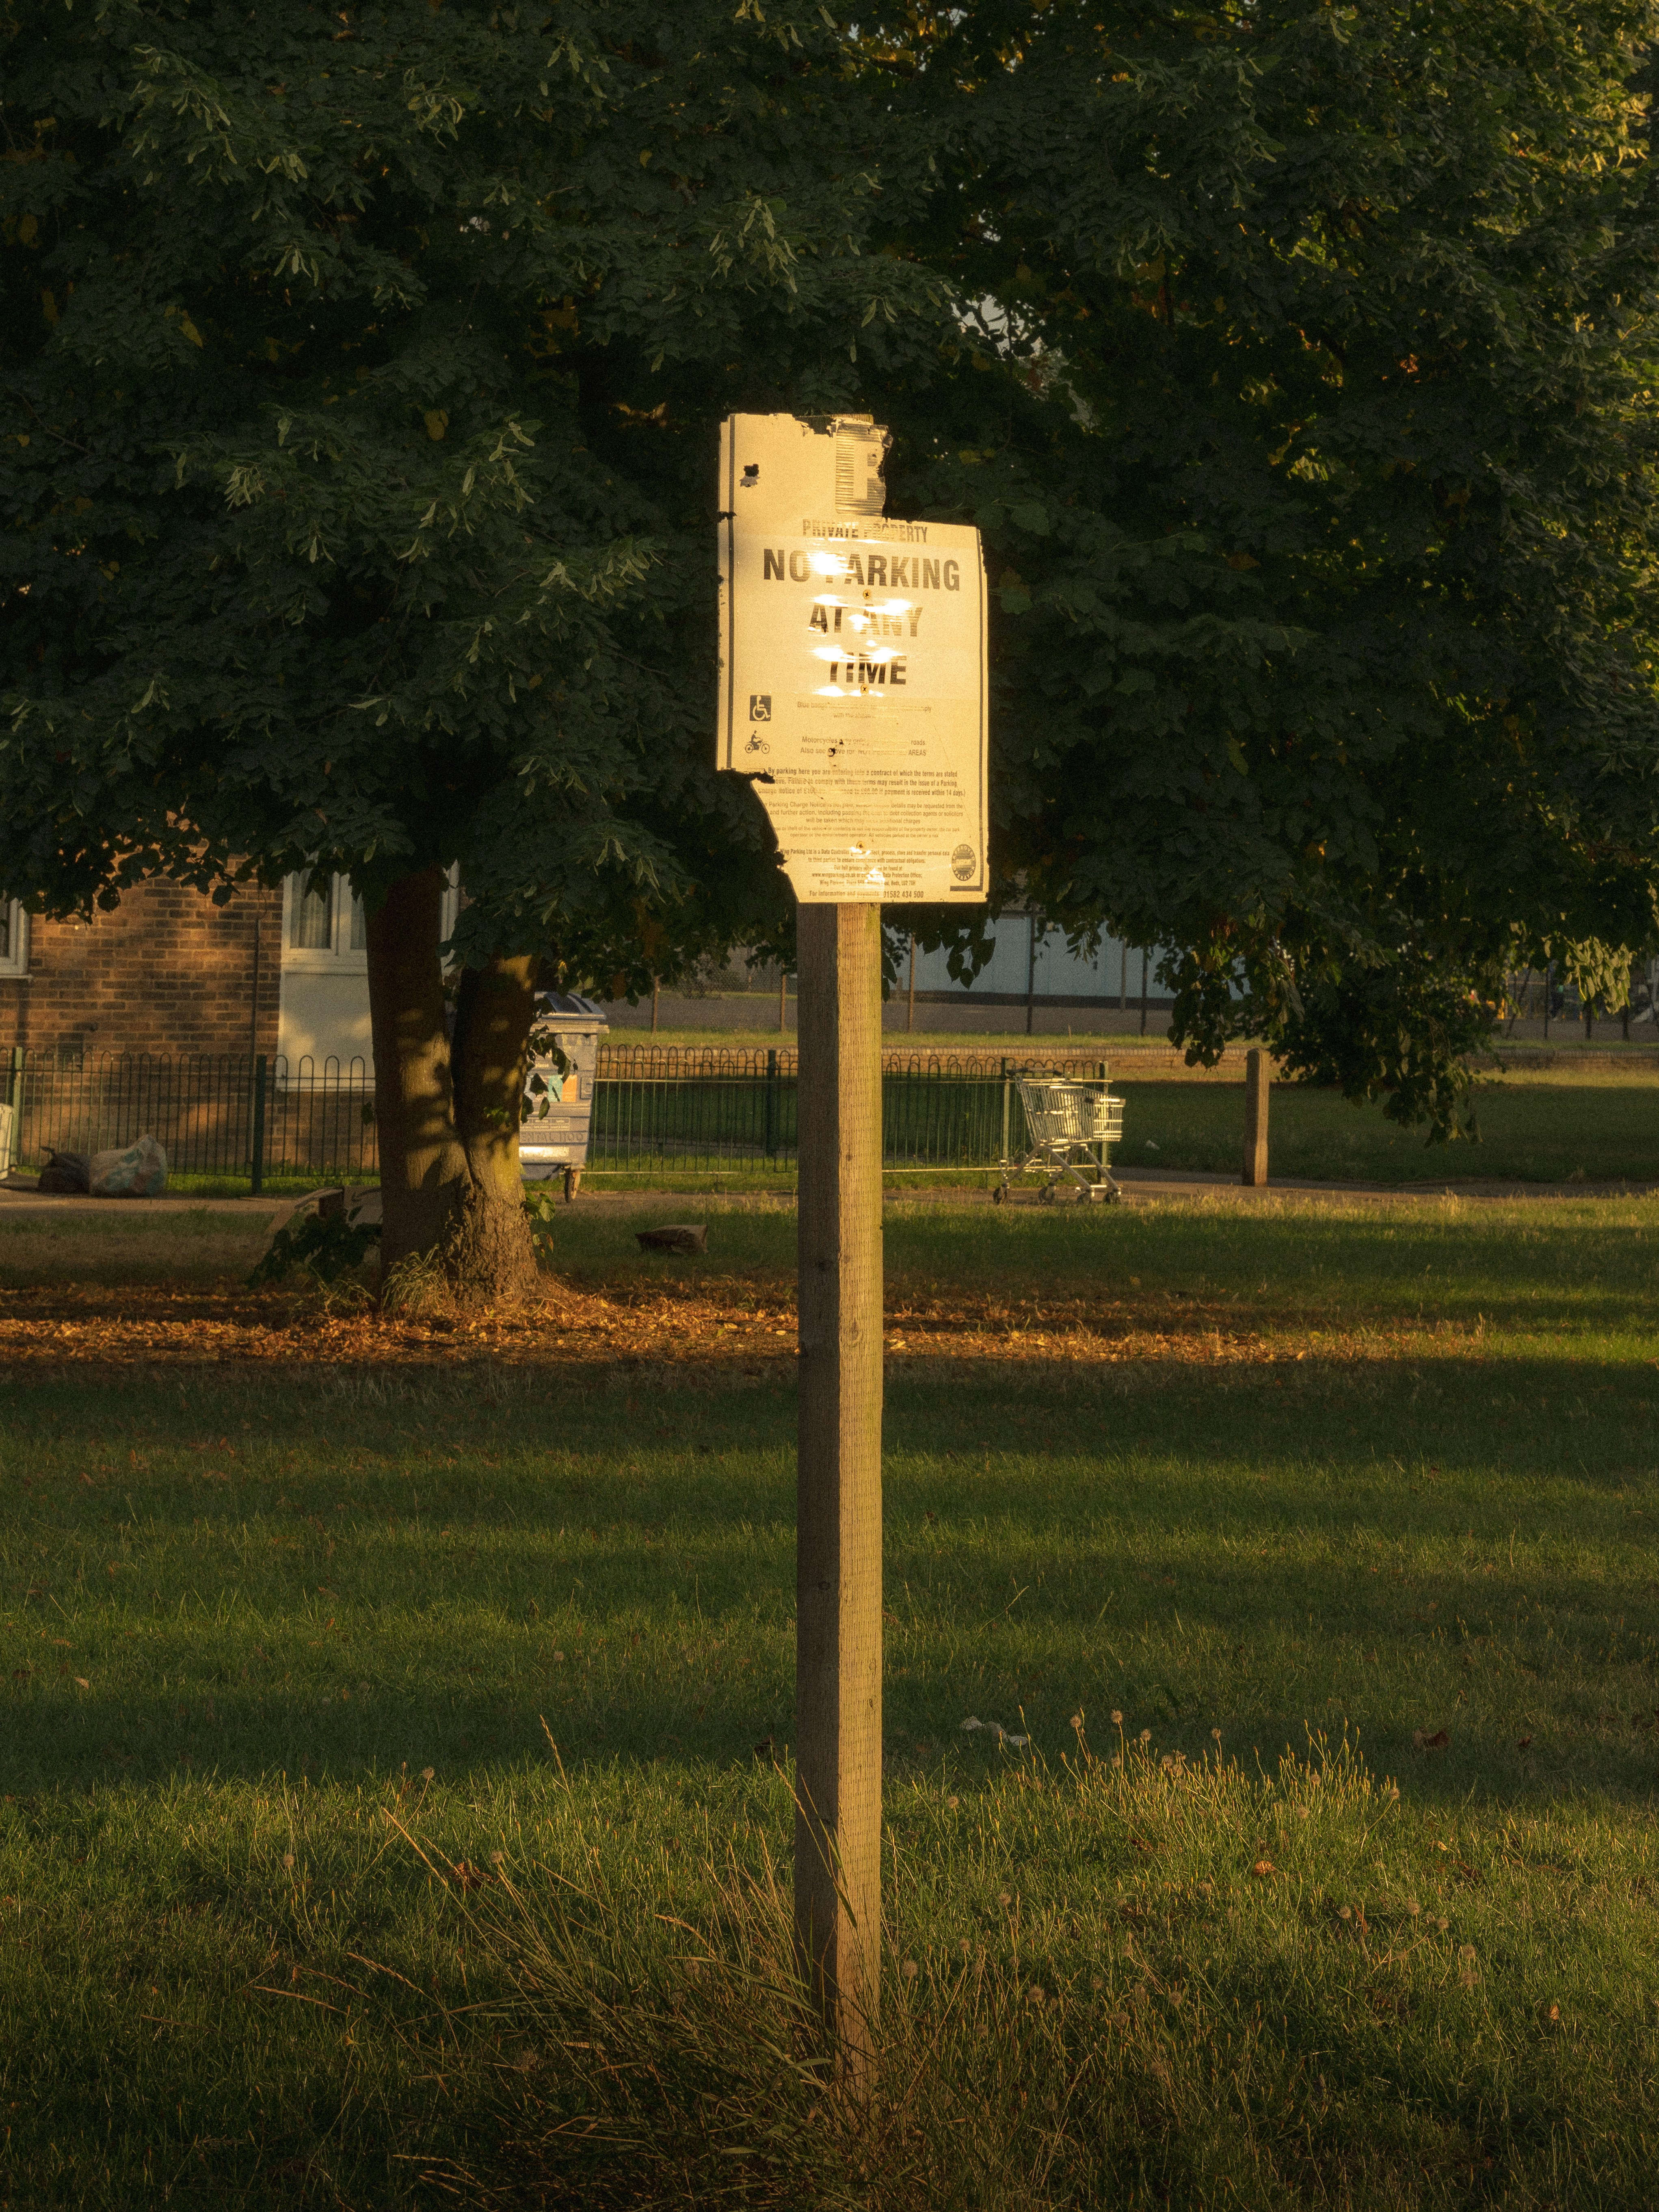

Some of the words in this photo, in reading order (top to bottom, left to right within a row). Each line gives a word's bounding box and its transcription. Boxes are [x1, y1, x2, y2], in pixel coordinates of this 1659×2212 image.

[802, 519, 859, 538] PRIVATE
[864, 523, 928, 543] PROPERTY
[764, 549, 811, 582] NO
[825, 554, 960, 591] ARKING
[809, 603, 848, 634] AT
[859, 603, 924, 637] ANY
[829, 652, 907, 685] TIME
[768, 767, 775, 775] By
[777, 767, 797, 776] parking
